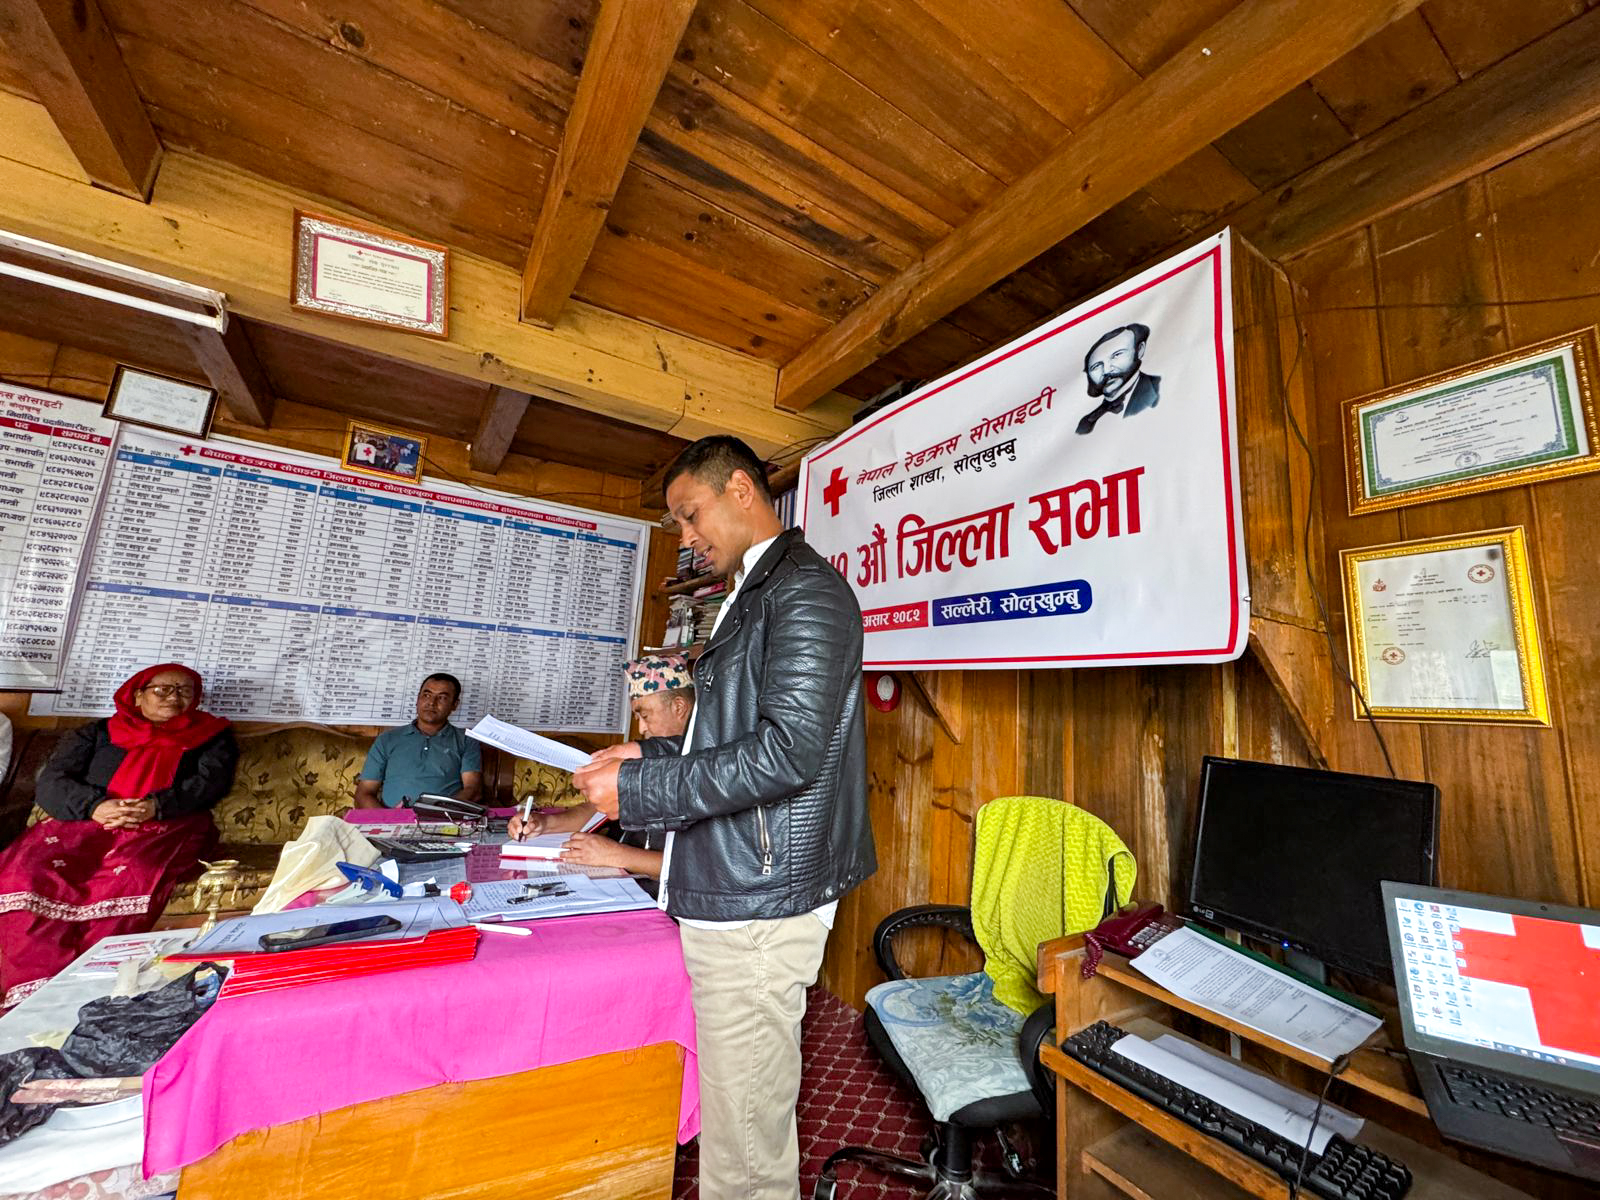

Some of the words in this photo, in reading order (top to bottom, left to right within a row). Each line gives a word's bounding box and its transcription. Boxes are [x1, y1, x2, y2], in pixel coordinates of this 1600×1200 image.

[856, 461, 898, 485] नेपाल
[904, 433, 962, 473] रेडक्रस
[969, 386, 1057, 444] सोसाइटी
[873, 479, 905, 503] जिल्ला
[909, 466, 945, 491] शाखा,
[953, 438, 1017, 475] सोलुखुम्बु
[897, 503, 1015, 579] जिल्ला
[1028, 466, 1145, 555] सभा
[863, 612, 891, 627] असार
[893, 609, 920, 624] २०८२
[1000, 588, 1081, 614] सोलुखुम्बु
